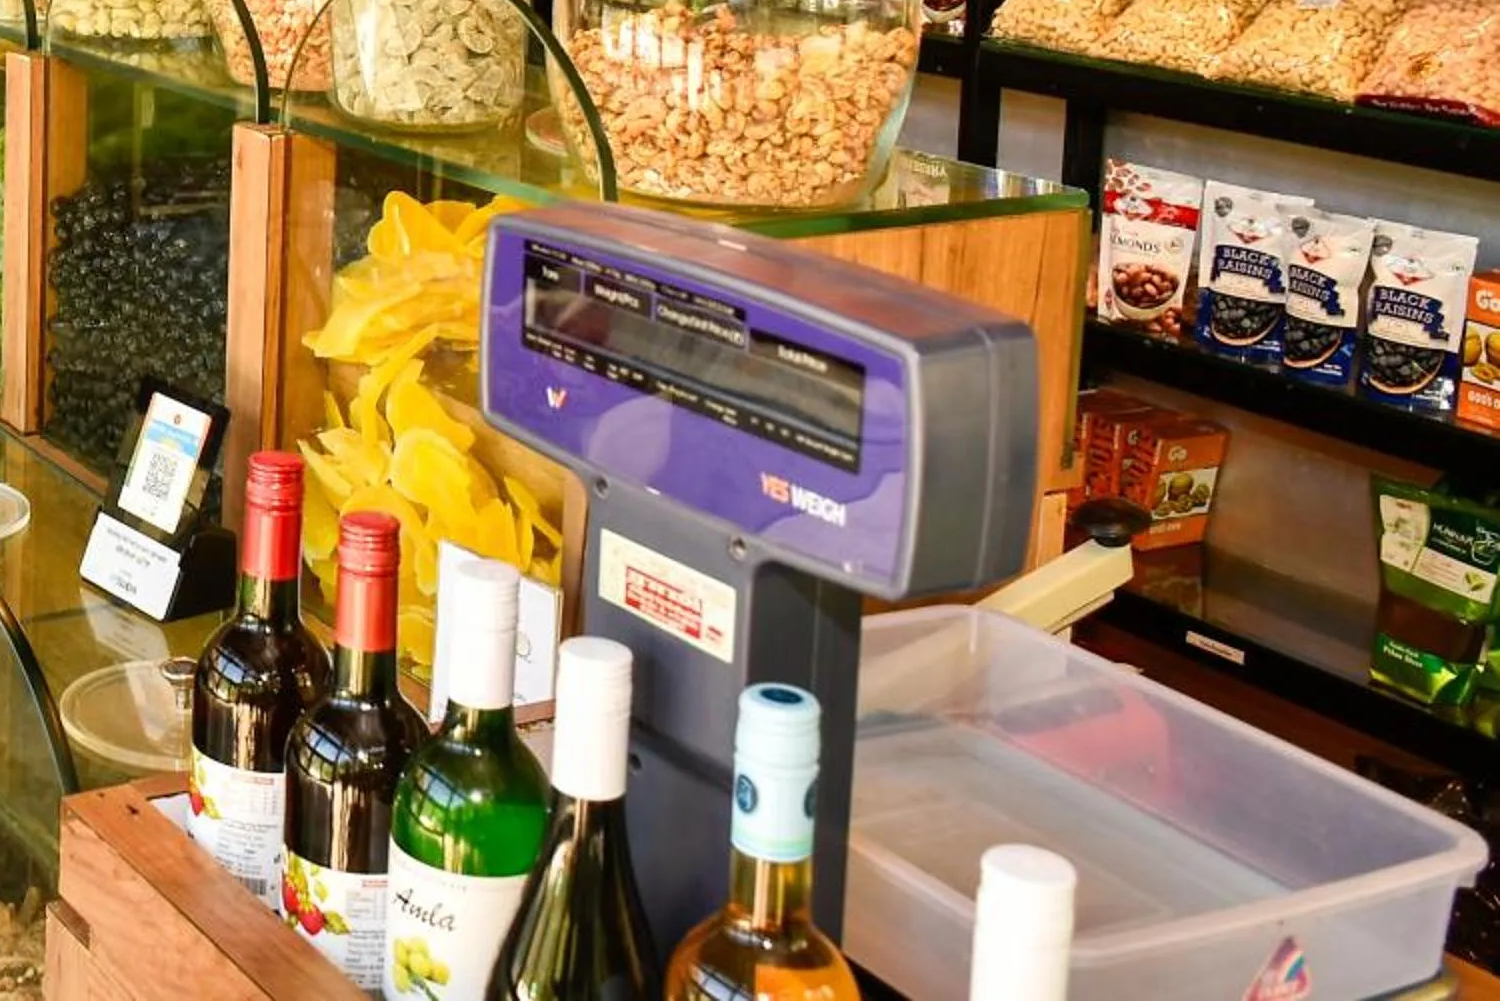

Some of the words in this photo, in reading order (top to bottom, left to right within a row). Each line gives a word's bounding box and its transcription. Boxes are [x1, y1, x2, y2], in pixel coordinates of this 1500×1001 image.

[1222, 246, 1271, 266] BLACK
[1217, 259, 1273, 280] RAISINS
[1290, 266, 1327, 288] BLACK
[1380, 289, 1429, 310] BLACK
[1374, 301, 1434, 324] RAISINS
[761, 472, 789, 503] YES
[791, 484, 847, 528] WEIGH
[393, 886, 457, 932] Amla
